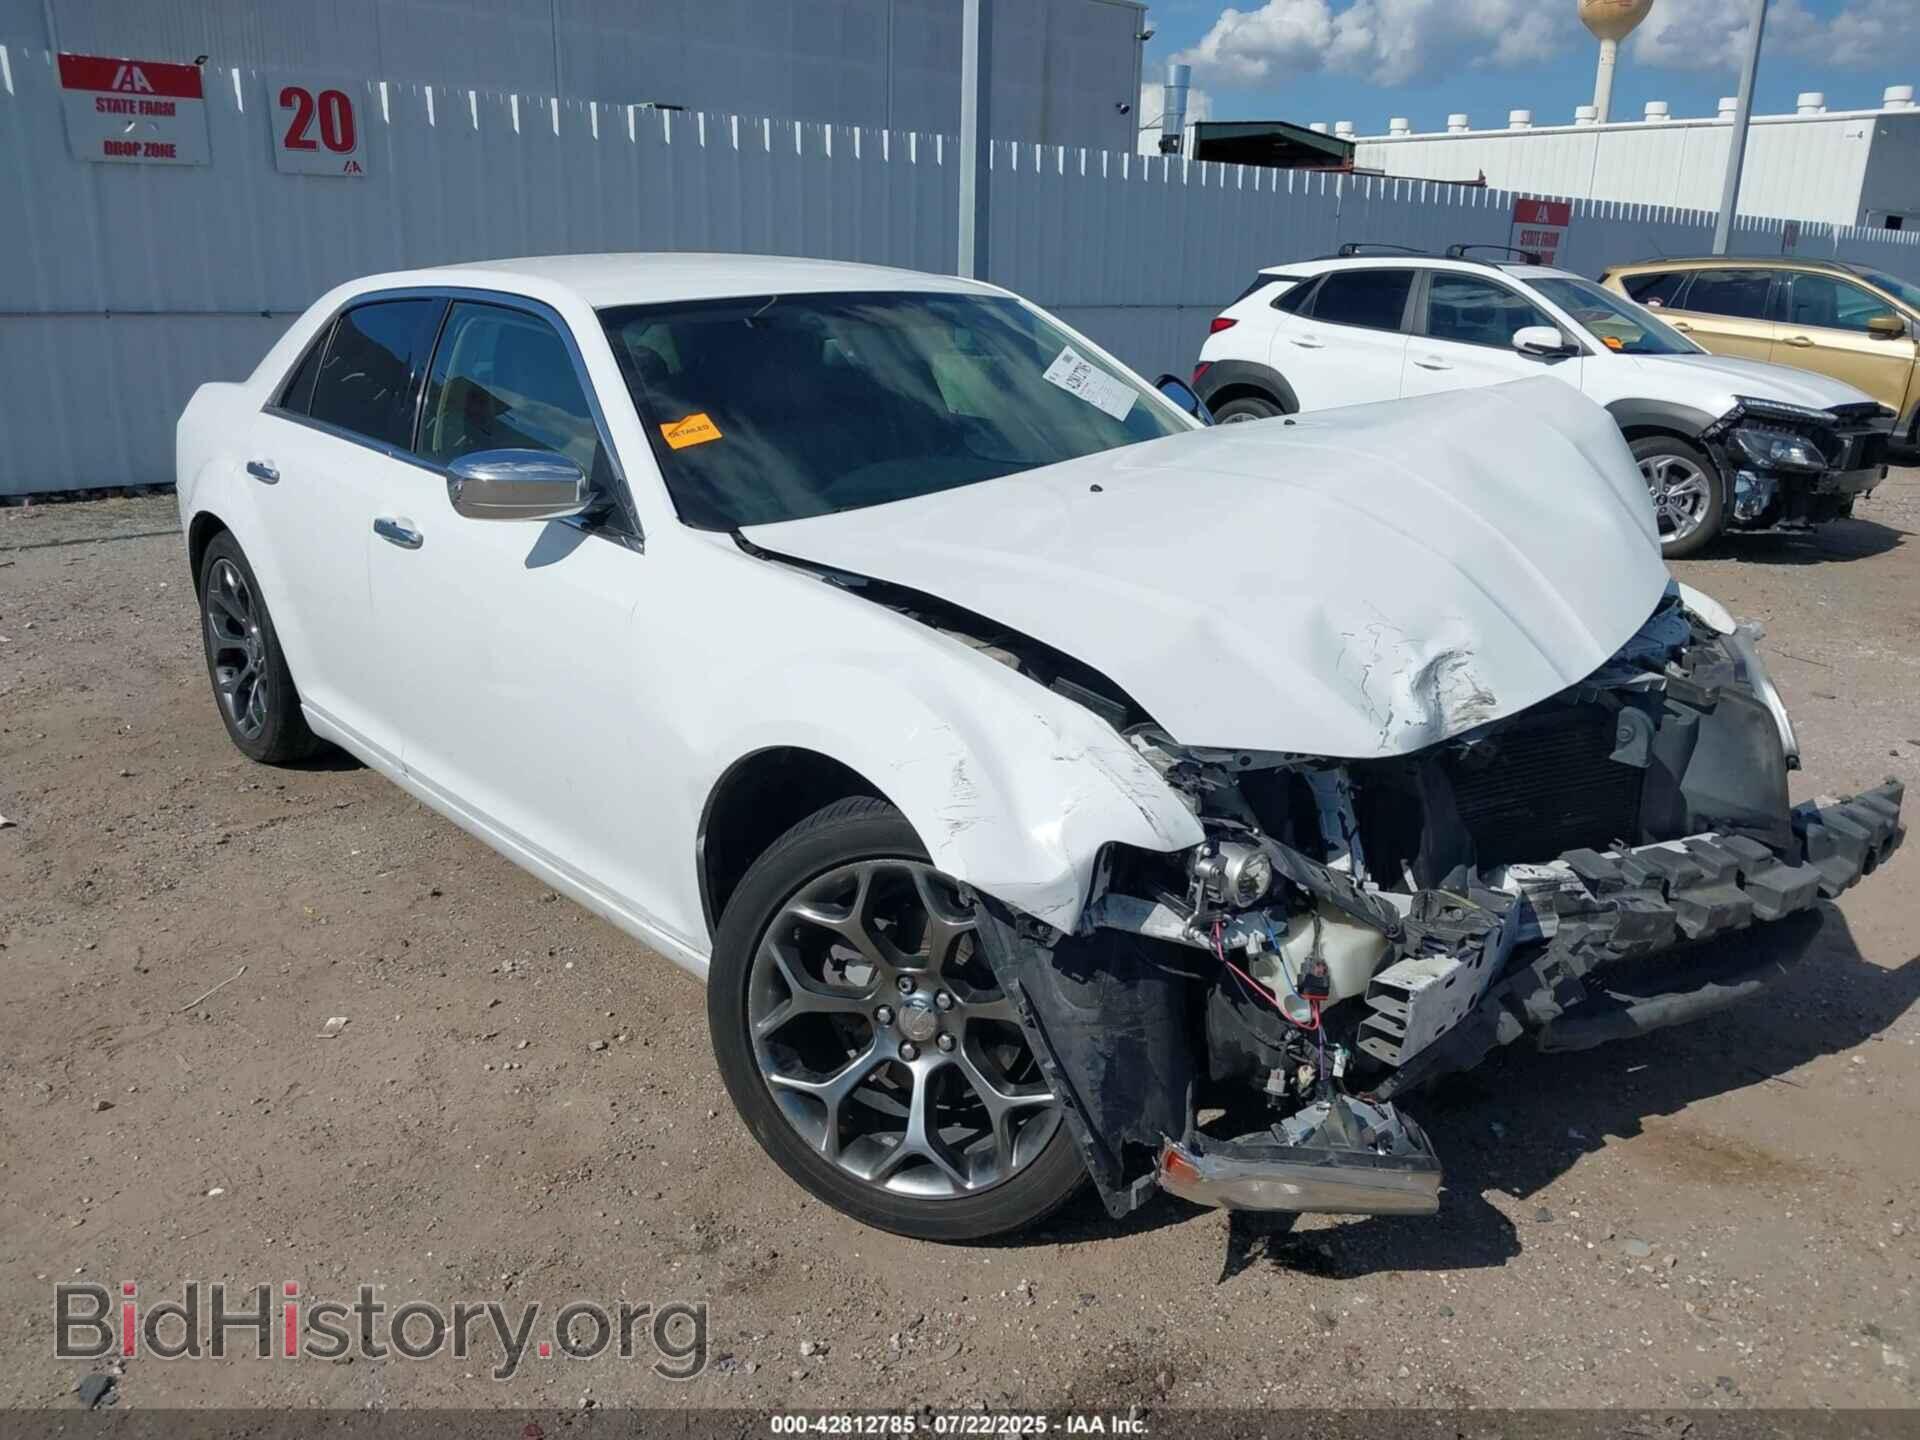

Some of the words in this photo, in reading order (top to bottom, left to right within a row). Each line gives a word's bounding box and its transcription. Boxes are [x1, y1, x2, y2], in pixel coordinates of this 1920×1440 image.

[95, 97, 137, 116] STATE
[138, 101, 176, 117] FARM
[279, 86, 359, 154] 20
[103, 140, 142, 157] DROP
[143, 142, 177, 159] ZONE
